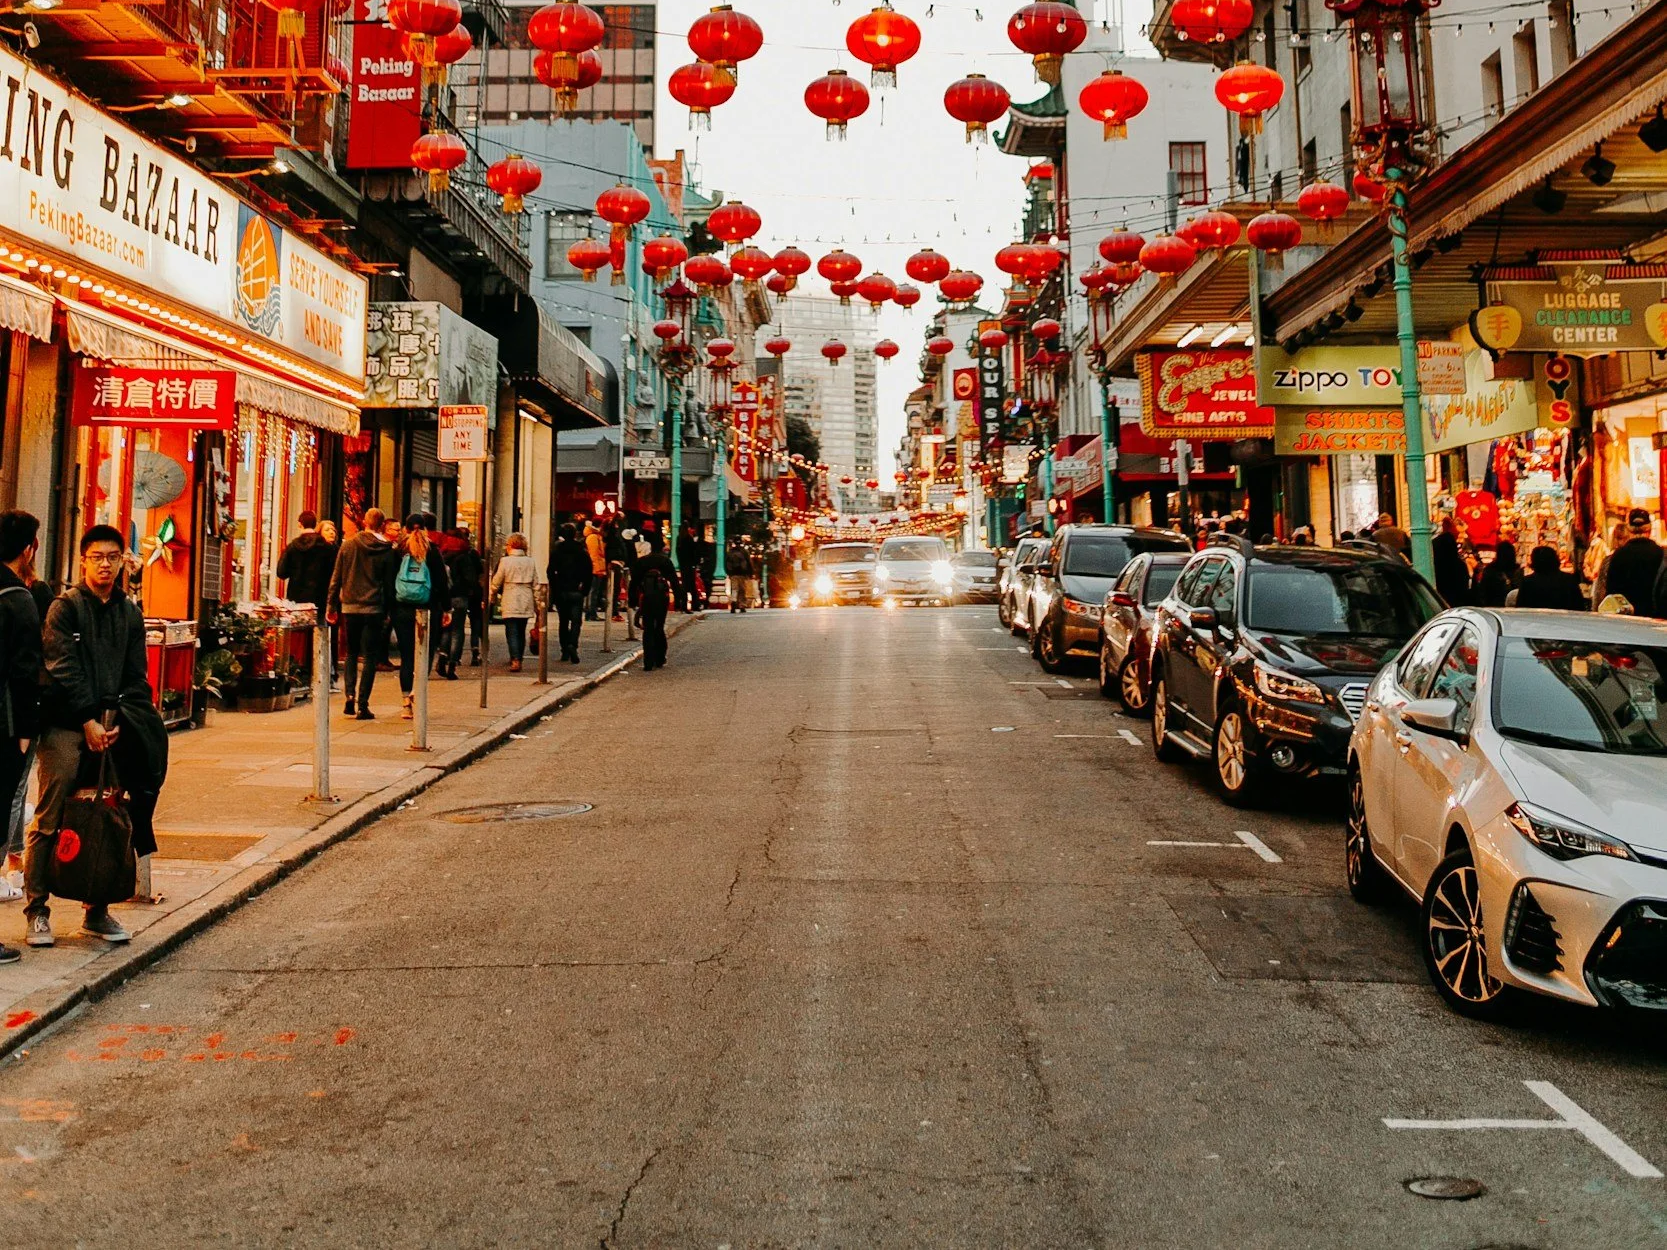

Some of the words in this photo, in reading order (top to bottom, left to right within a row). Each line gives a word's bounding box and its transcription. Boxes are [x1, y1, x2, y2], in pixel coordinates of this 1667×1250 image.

[360, 57, 414, 76] Peking
[358, 85, 415, 102] Bazaar
[100, 134, 219, 265] BAZAAR
[29, 190, 145, 269] PekingBazaar.com
[289, 251, 316, 299] SERVE
[318, 269, 359, 320] YOURSELF
[1544, 292, 1621, 308] LUGGAGE
[1535, 309, 1632, 326] CLEARANCE
[304, 309, 321, 347] AND
[323, 318, 343, 358] SAVE
[1552, 327, 1618, 343] CENTER
[1274, 368, 1348, 392] zippo
[92, 377, 218, 410] 清倉特價
[441, 416, 453, 428] NO
[1174, 411, 1204, 423] FINE
[1208, 411, 1246, 423] ARTS
[1305, 411, 1404, 429] SHIRTS
[454, 431, 471, 439] ANY
[453, 442, 473, 450] TIME
[629, 459, 666, 467] CLAY
